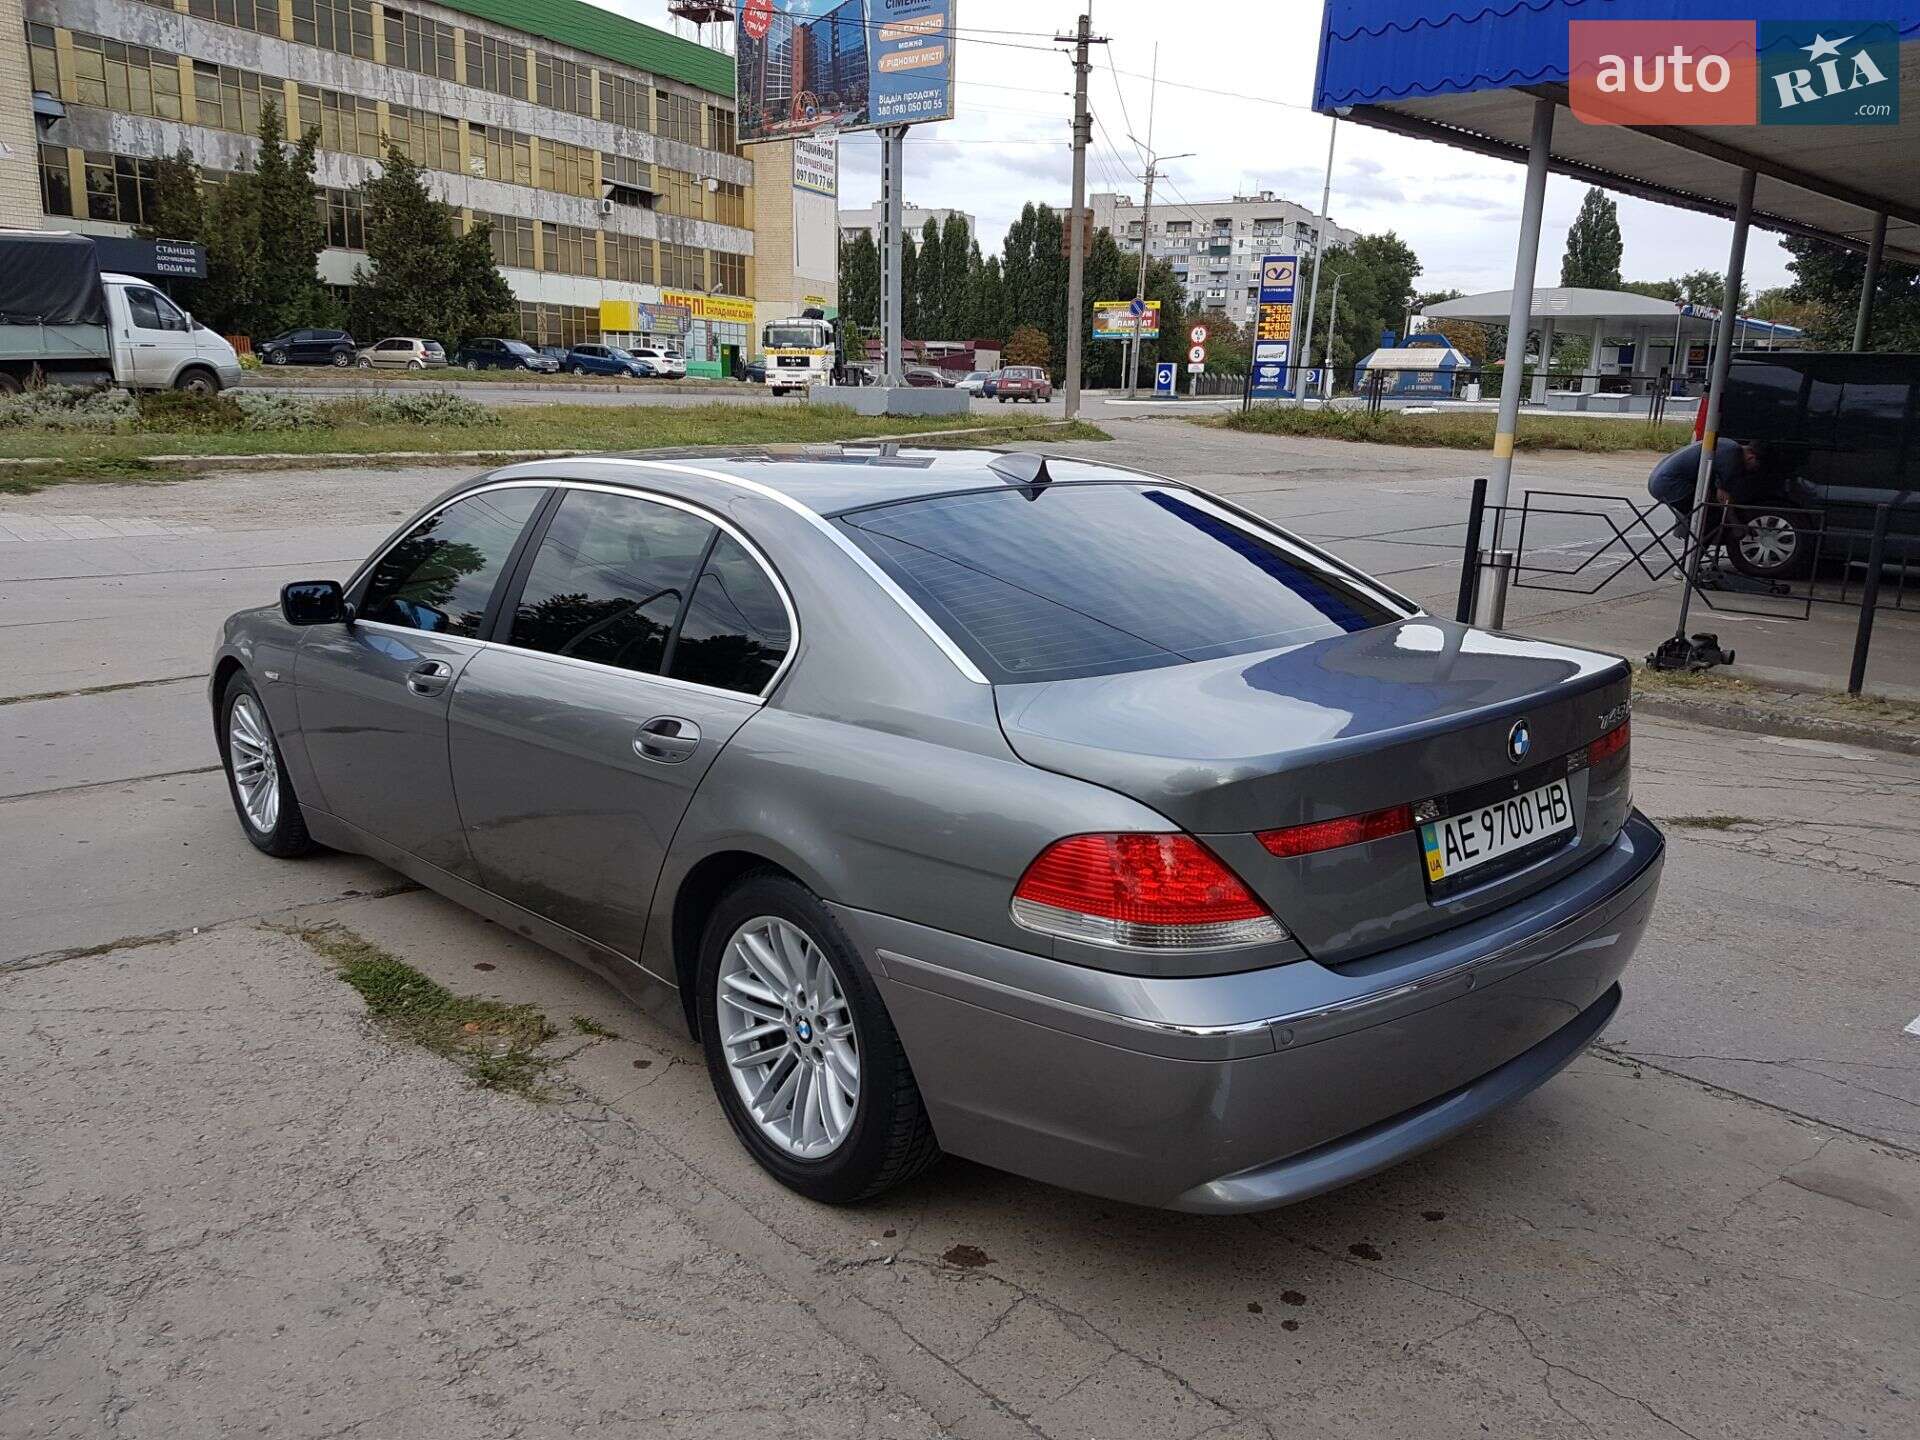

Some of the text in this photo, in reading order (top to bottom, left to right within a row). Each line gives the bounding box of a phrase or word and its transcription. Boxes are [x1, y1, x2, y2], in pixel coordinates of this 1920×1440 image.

[921, 51, 943, 62] МІСТІ
[879, 88, 942, 105] Відділ продажу:
[892, 104, 906, 116] (98)
[907, 102, 922, 113] 050
[922, 100, 933, 111] 00
[933, 99, 943, 109] 55
[796, 168, 808, 182] 097
[155, 245, 196, 256] СТАНЦІЯ
[157, 263, 184, 272] ВОДИ
[1194, 349, 1200, 359] 5
[1443, 784, 1568, 867] AE 9700 HB
[1429, 859, 1442, 871] UA
